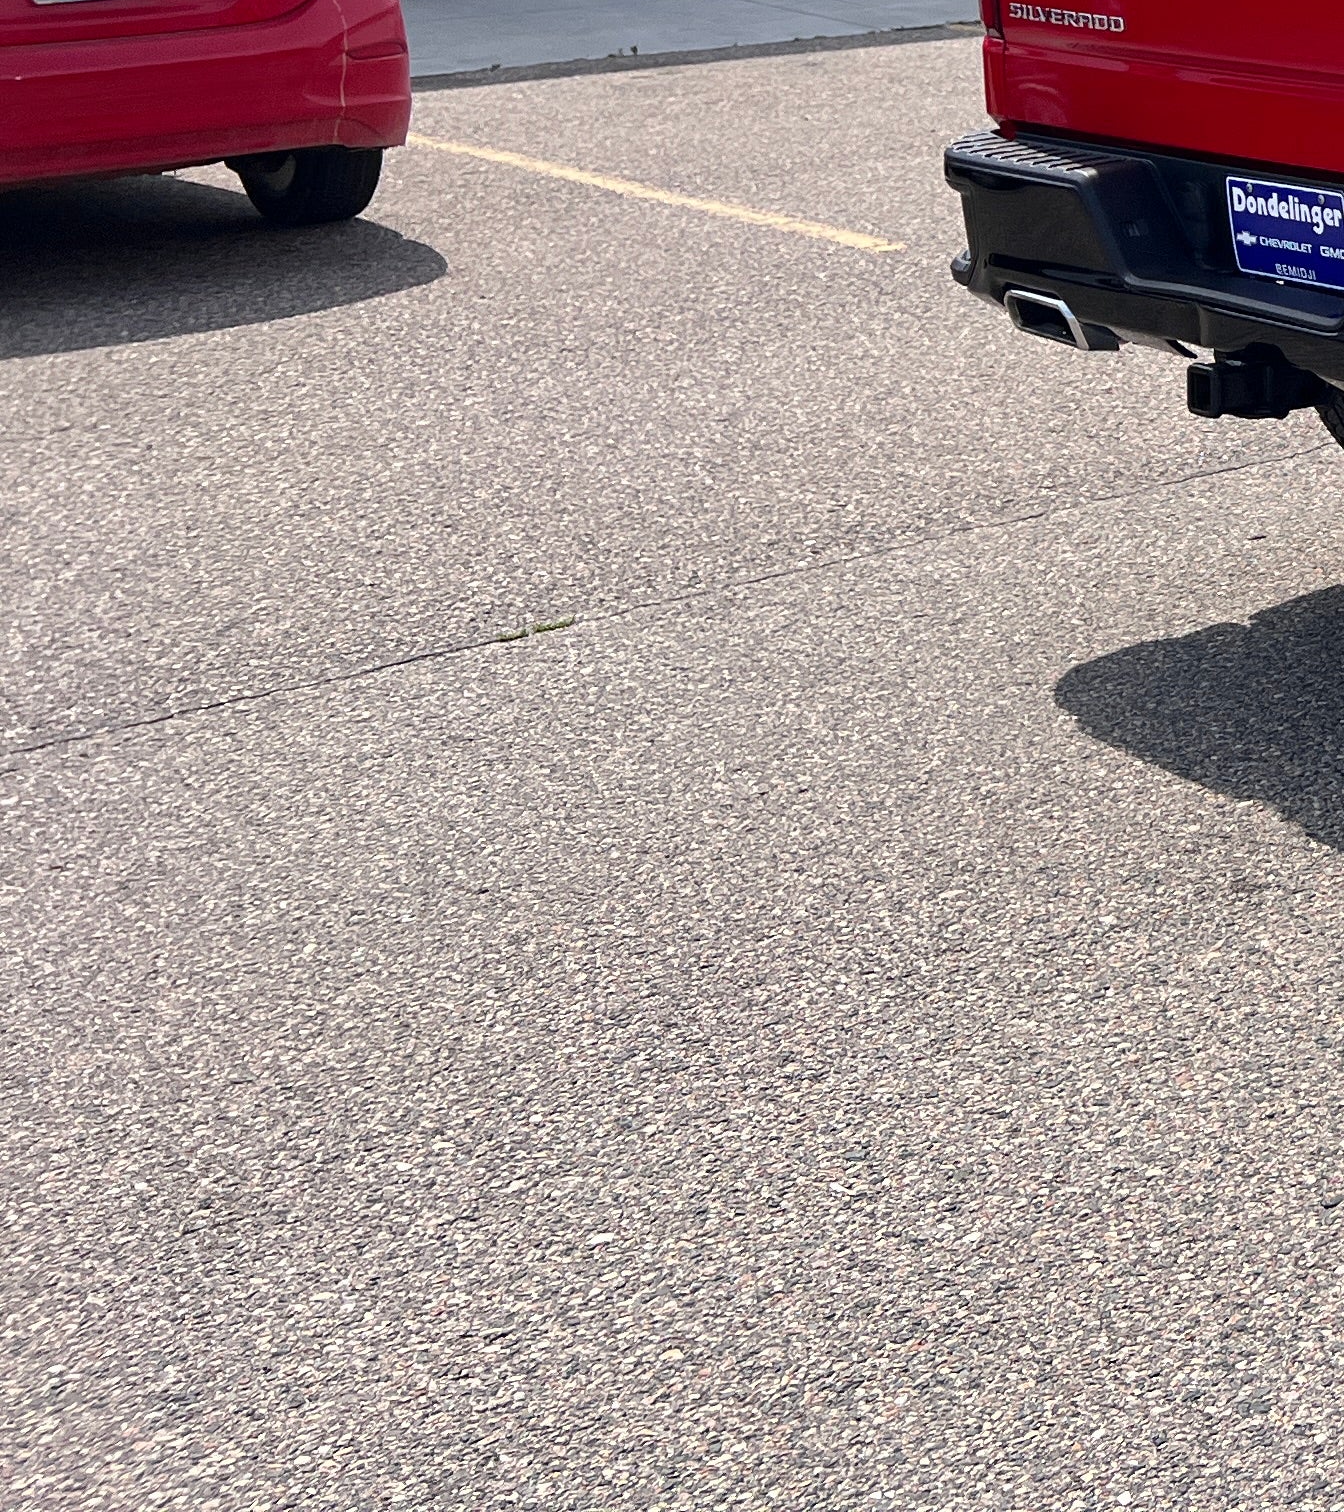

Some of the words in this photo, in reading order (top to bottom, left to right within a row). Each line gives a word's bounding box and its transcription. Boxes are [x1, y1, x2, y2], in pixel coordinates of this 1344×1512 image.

[1008, 1, 1126, 33] SILVERADO
[1231, 186, 1343, 235] Dondelinger
[1259, 236, 1313, 254] CHEVROLET
[1275, 263, 1317, 281] BEMIDJI
